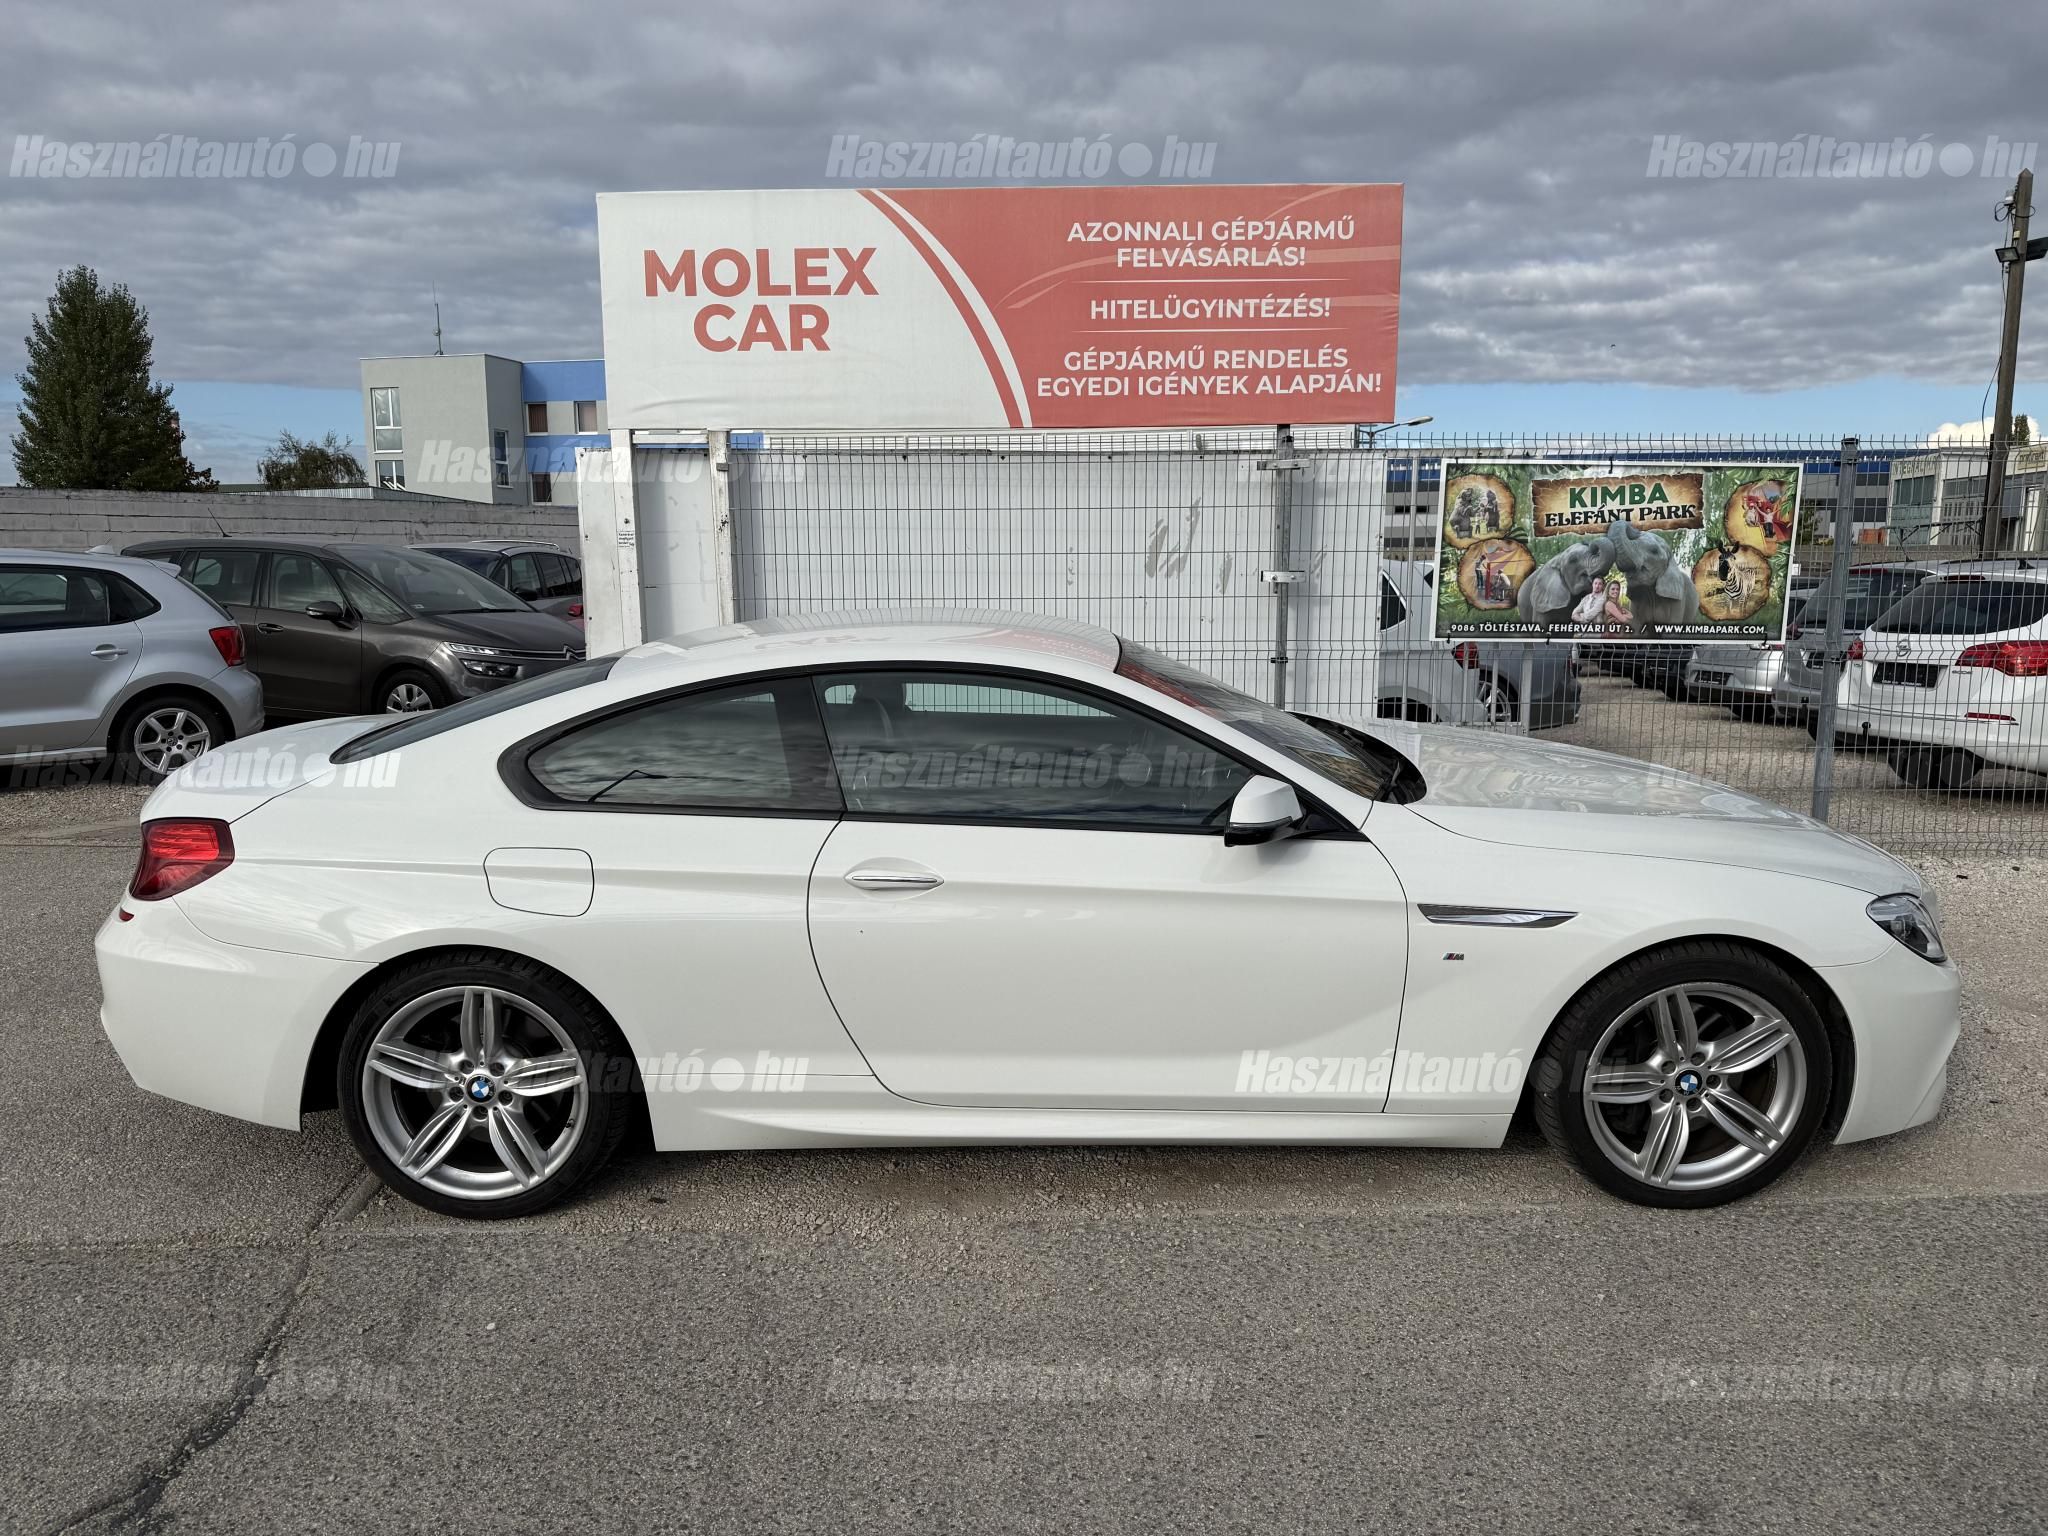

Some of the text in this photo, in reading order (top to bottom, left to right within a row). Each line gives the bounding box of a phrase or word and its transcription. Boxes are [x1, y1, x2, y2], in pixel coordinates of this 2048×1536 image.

[1067, 215, 1355, 242] AZONNALI GÉPJÁRMŰ
[1117, 242, 1306, 268] FELVÁSÁRLÁS!
[644, 247, 879, 297] MOLEX
[1090, 294, 1331, 320] HITELÜGYINTÉZÉS!
[694, 303, 831, 353] CAR
[1064, 344, 1348, 372] GÉPJÁRMŰ RENDELÉS
[1037, 369, 1382, 397] EGYEDI IGÉNYEK ALAPJÁN!
[1569, 482, 1669, 508] KIMBA
[1544, 503, 1696, 527] ELEFÁNT PARK
[1451, 623, 1475, 632] 9086
[1479, 622, 1545, 633] TÖLTÉSTAVA,
[1549, 622, 1605, 633] FEHÉRVÁRI
[1609, 622, 1622, 633] ÚT
[1624, 625, 1633, 633] 2.
[1654, 624, 1765, 634] WWW.KIMBAPARK.COM
